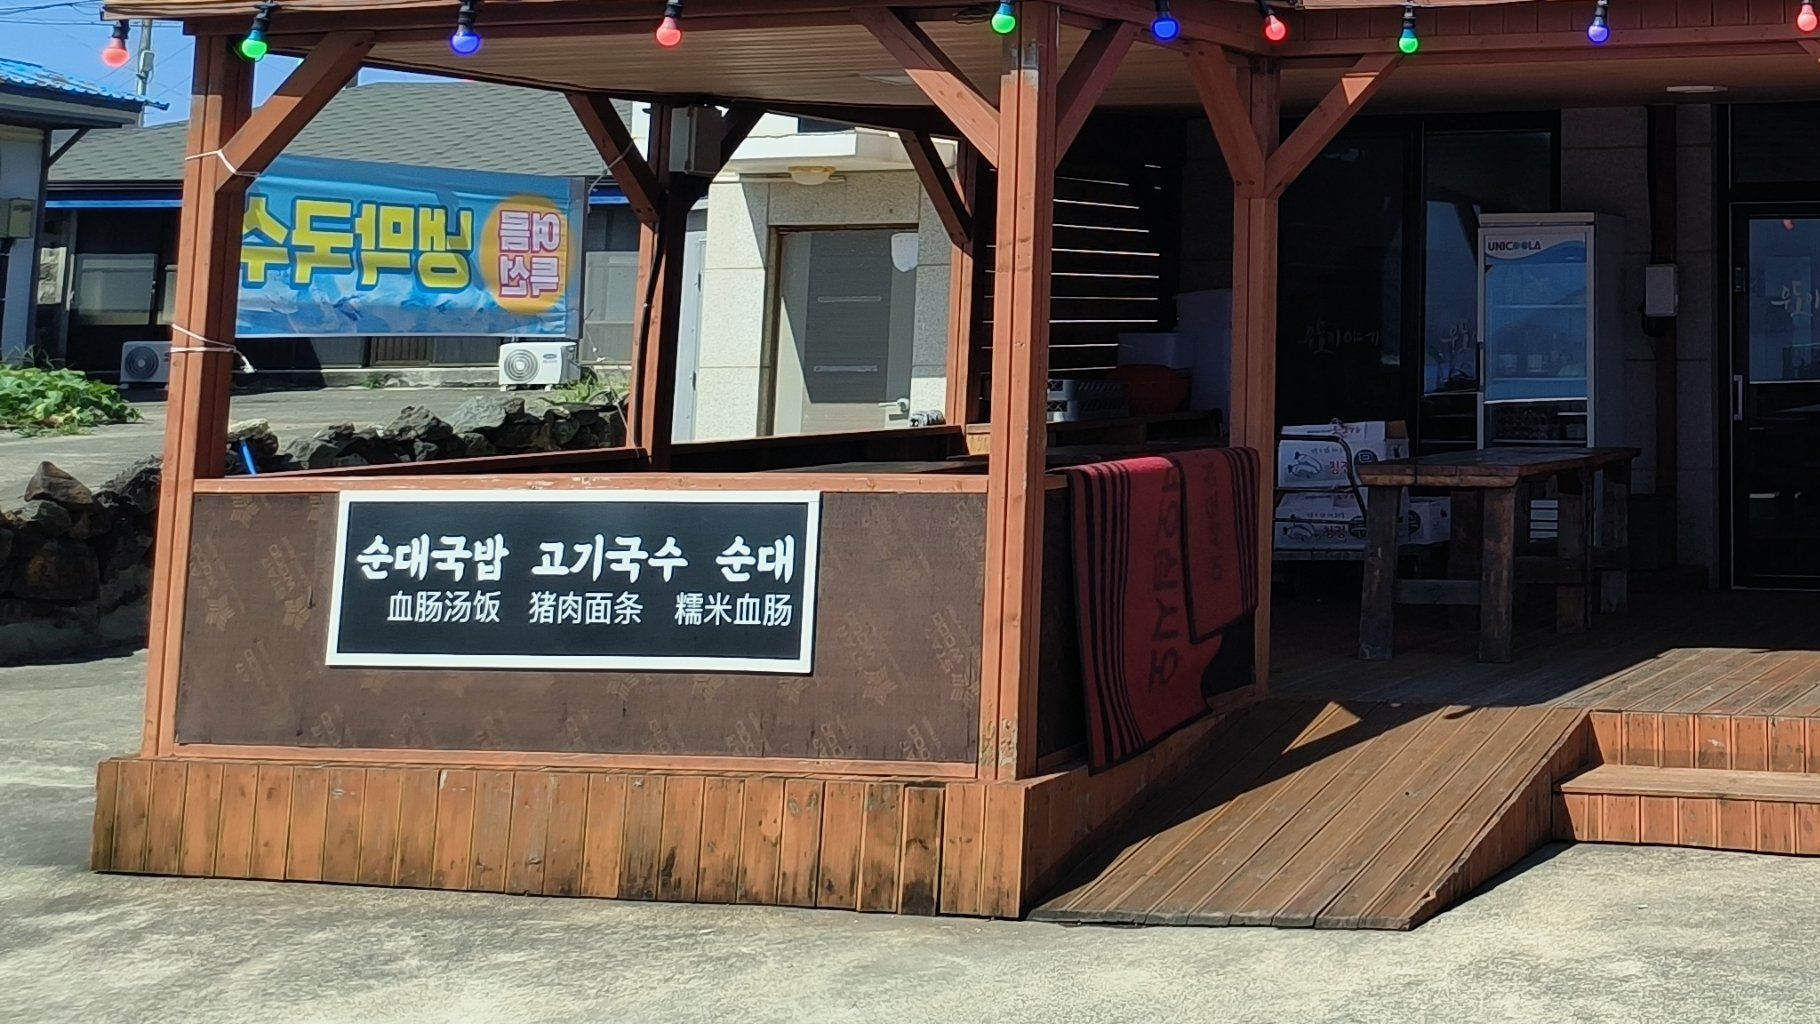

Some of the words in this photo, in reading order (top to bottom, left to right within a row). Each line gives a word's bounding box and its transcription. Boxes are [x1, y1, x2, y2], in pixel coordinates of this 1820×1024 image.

[356, 533, 510, 581] 순대국밥
[531, 534, 690, 583] 고기국수
[716, 534, 796, 584] 순대
[387, 590, 501, 624] 血肠汤饭
[528, 591, 644, 625] 猪肉面条
[675, 592, 792, 628] 糯米血肠
